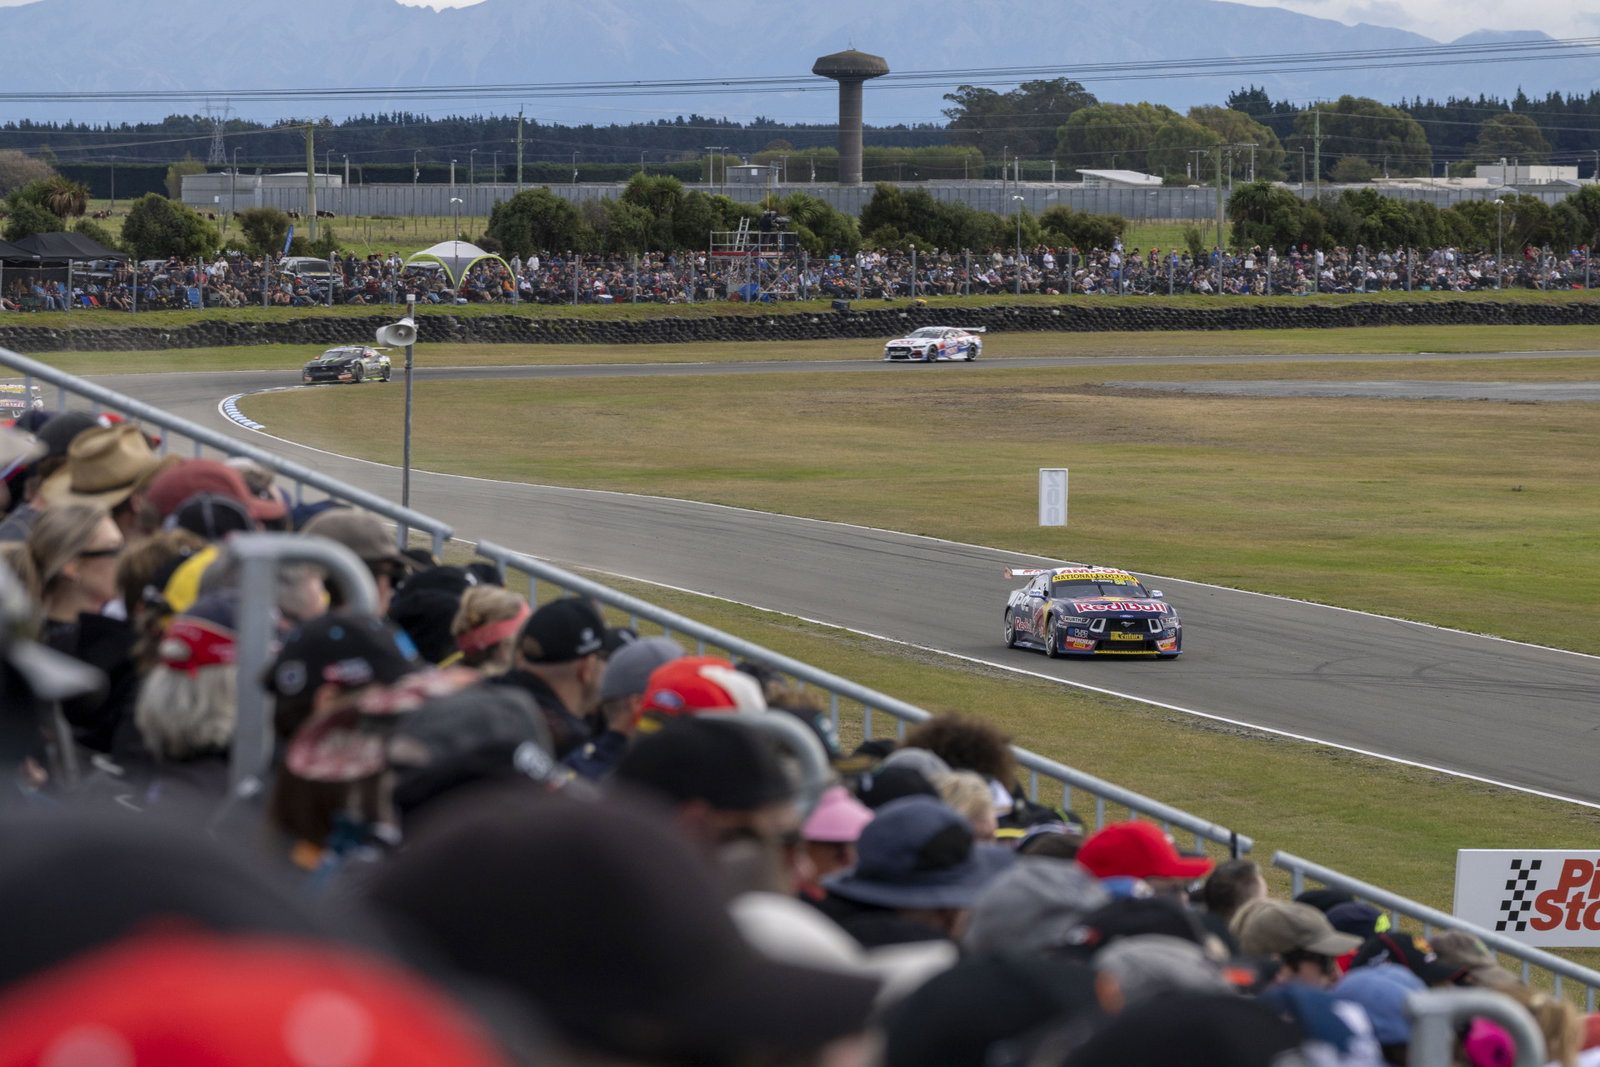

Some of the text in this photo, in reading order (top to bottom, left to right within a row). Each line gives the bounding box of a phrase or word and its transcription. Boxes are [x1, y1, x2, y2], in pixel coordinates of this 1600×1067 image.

[1054, 573, 1093, 581] NATIONAL
[1074, 602, 1122, 613] Red
[1122, 602, 1168, 613] Bull
